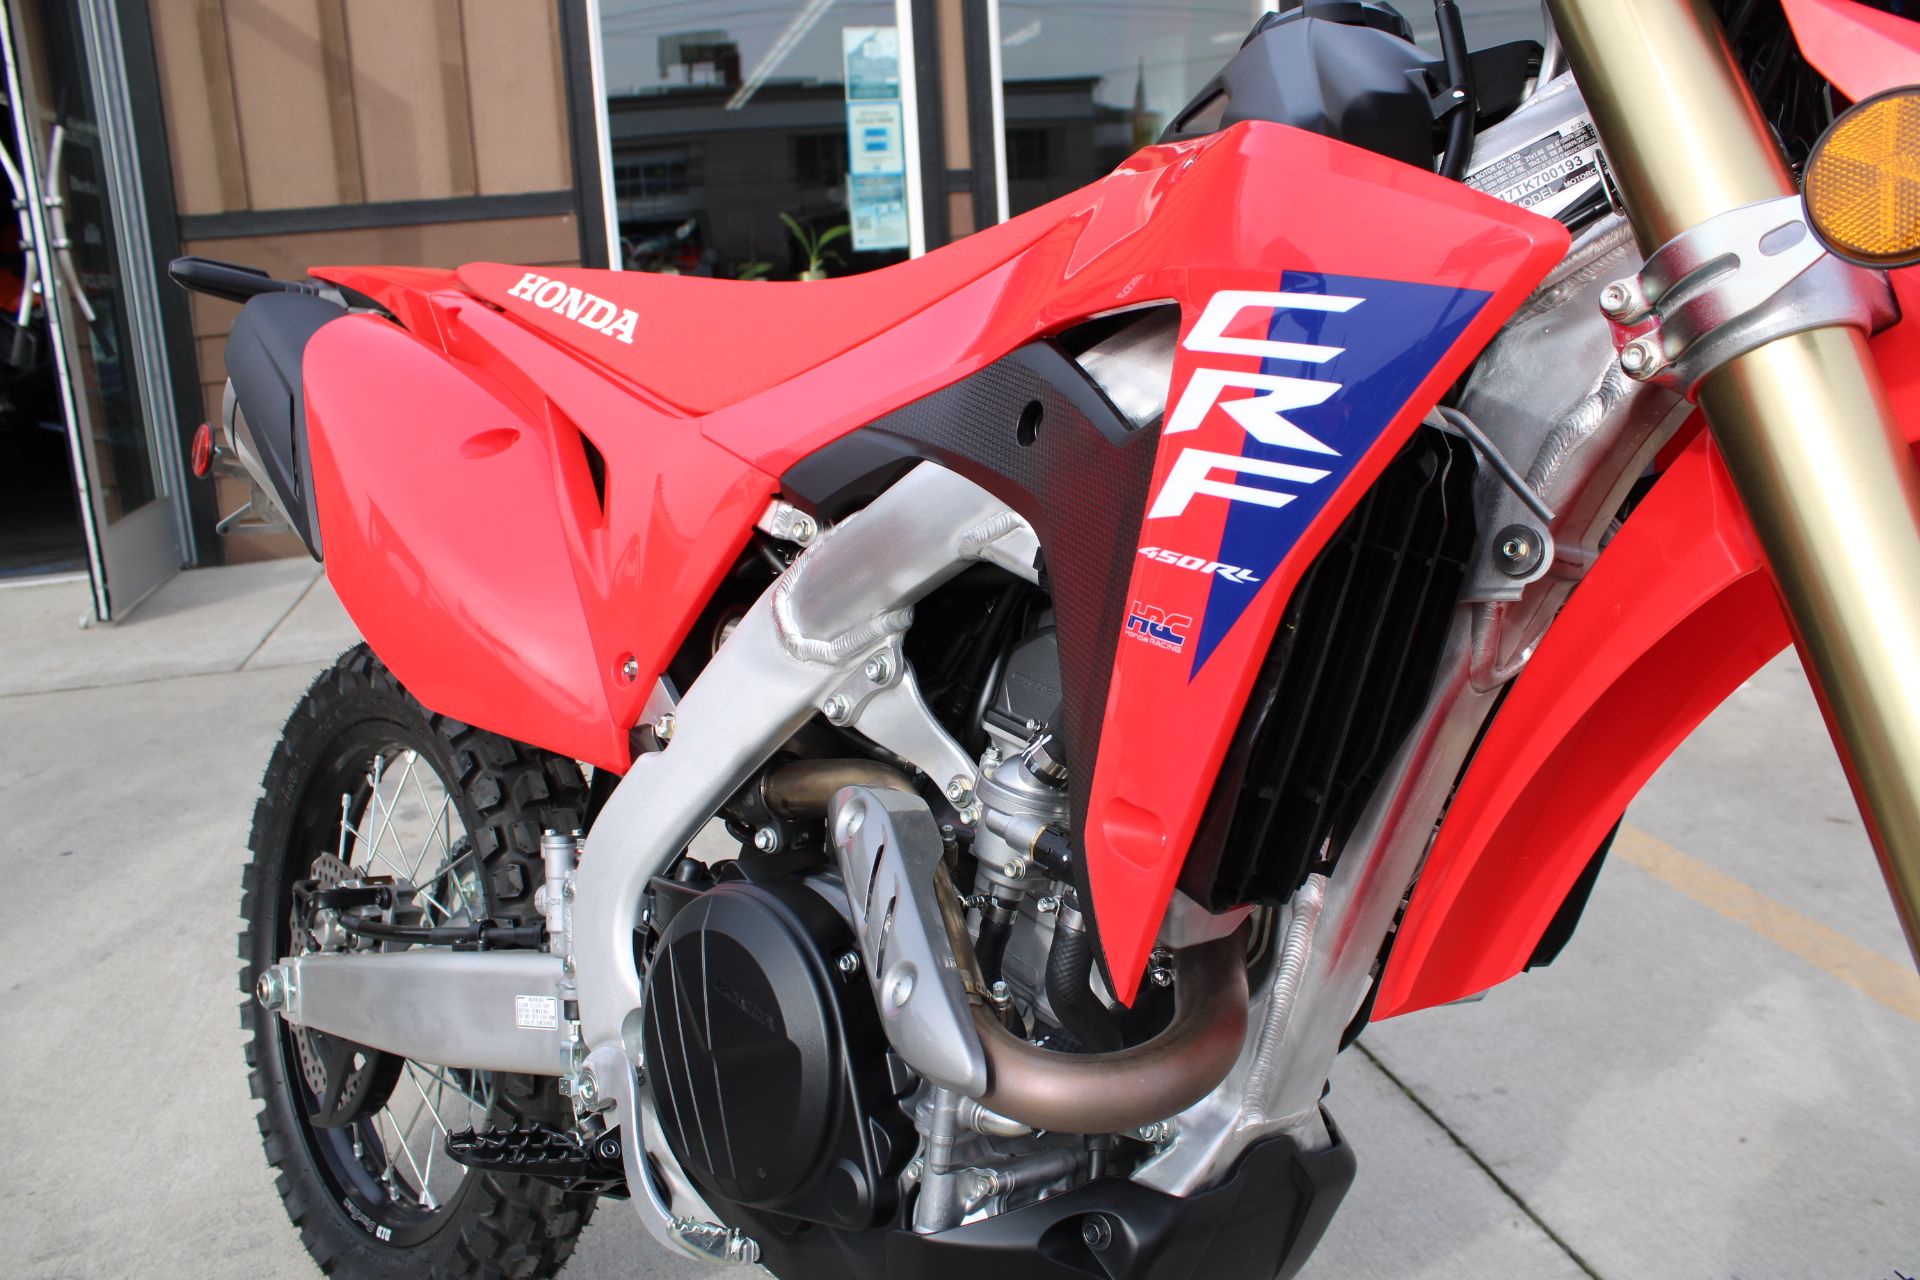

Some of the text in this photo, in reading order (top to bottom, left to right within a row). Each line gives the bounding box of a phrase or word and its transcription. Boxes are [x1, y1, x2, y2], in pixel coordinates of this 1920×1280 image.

[1474, 165, 1496, 179] MOTOR
[1508, 152, 1522, 162] LTD.
[507, 272, 639, 345] HONDA
[1147, 290, 1367, 519] CRF
[1137, 546, 1261, 584] 450RL
[1126, 600, 1192, 647] HRC
[1148, 637, 1182, 653] RACING
